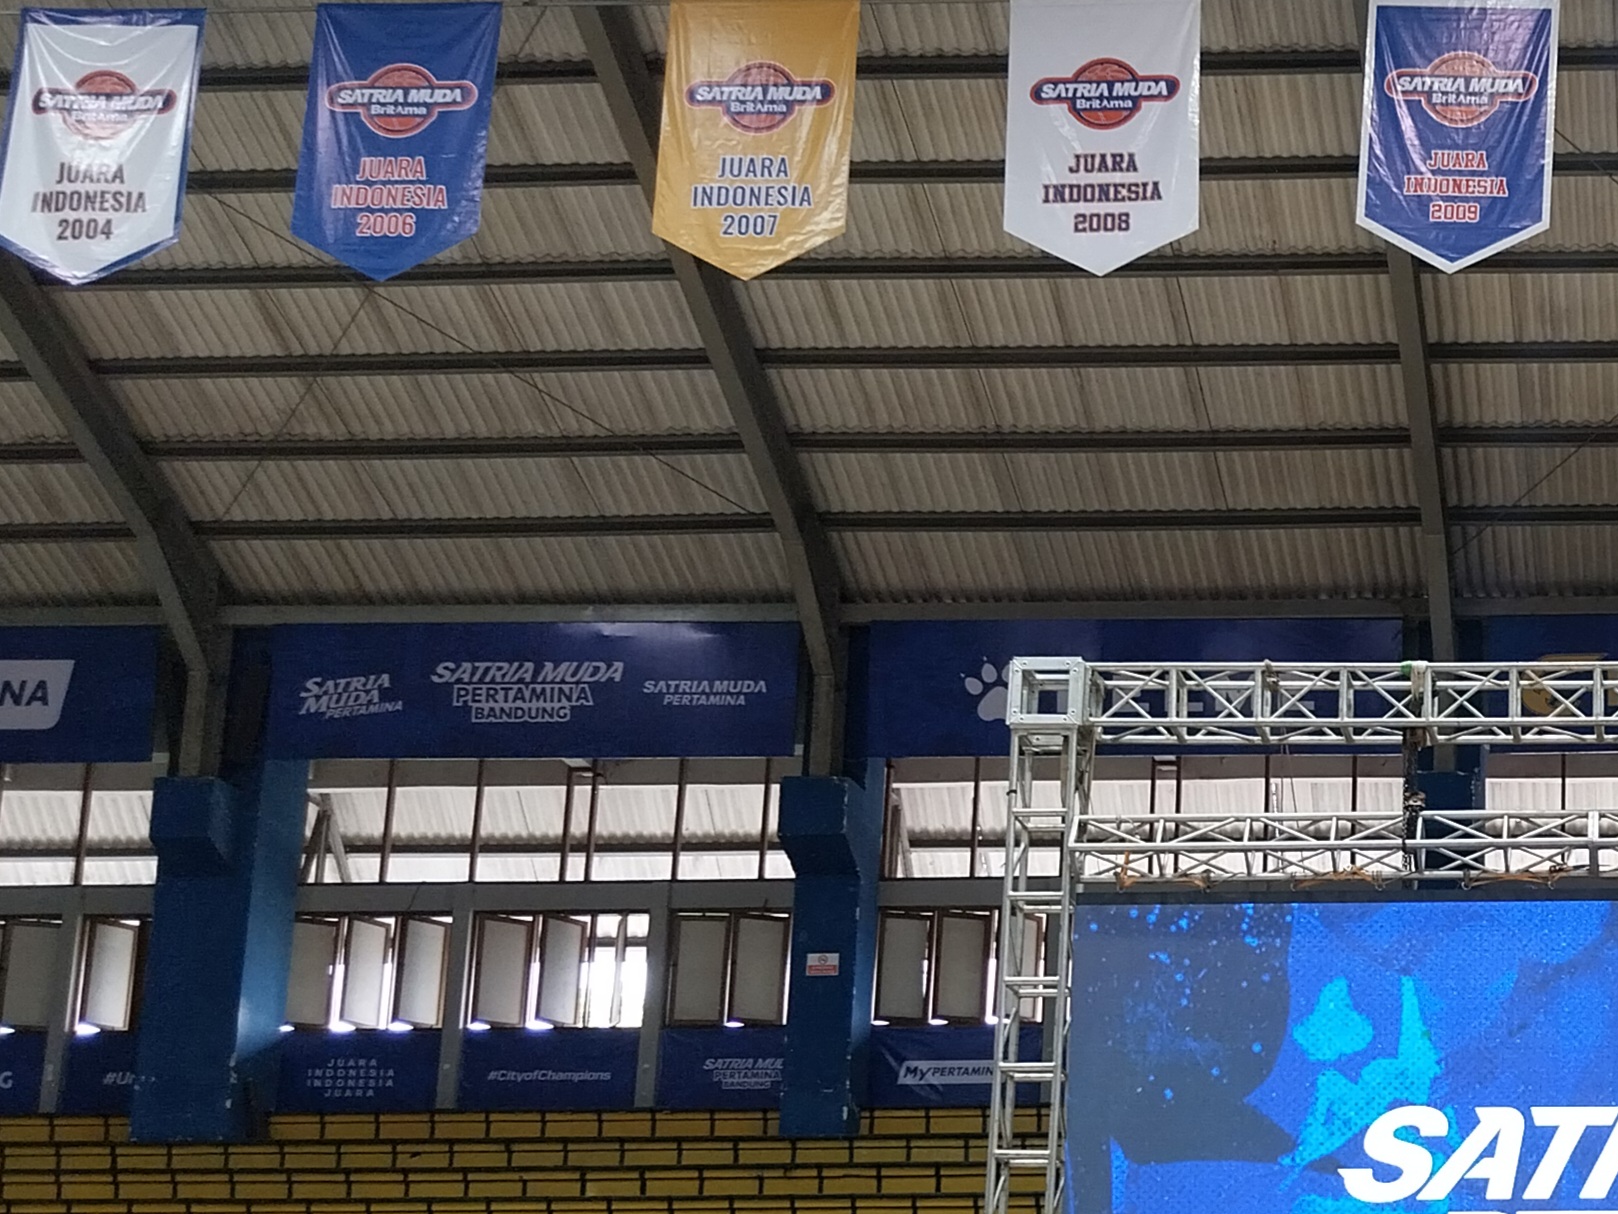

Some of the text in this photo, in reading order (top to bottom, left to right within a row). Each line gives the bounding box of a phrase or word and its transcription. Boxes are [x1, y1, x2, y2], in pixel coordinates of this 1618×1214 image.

[696, 85, 822, 101] SATRIA MUDA
[1041, 81, 1168, 98] SATRIA MUDA
[1399, 77, 1524, 93] SATRIA MUDA
[338, 88, 462, 103] SATRIA MUDA
[1075, 98, 1133, 109] BritAma
[1432, 92, 1488, 104] BritAma
[371, 104, 427, 115] BritAma
[730, 102, 787, 113] BritAma
[356, 156, 427, 180] JUARA
[718, 156, 789, 179] JUARA
[1068, 152, 1138, 174] JUARA
[1427, 150, 1488, 170] JUARA
[56, 161, 125, 185] JUARA
[1042, 181, 1163, 204] INDONESIA
[1404, 175, 1508, 197] INDONESIA
[31, 190, 147, 213] INDONESIA
[331, 185, 448, 209] INDONESIA
[692, 185, 813, 208] INDONESIA
[1430, 203, 1479, 222] 2009
[56, 218, 114, 241] 2004
[356, 213, 416, 237] 2006
[722, 214, 779, 237] 2007
[1073, 212, 1131, 233] 2008
[430, 661, 624, 683] SATRIA MUDA
[300, 674, 391, 697] SATRIA
[453, 685, 592, 705] PERTAMINA
[643, 680, 767, 695] SATRIA MUDA
[299, 690, 380, 715] MUDA
[662, 694, 746, 706] PERTAMINA
[325, 701, 403, 719] PERTAMINA
[472, 706, 570, 722] BANDUNG
[327, 1058, 378, 1068] JUARA
[703, 1058, 753, 1070] SATRIA
[307, 1068, 395, 1078] INDONESIA
[487, 1069, 612, 1083] #CityofChampions
[306, 1078, 394, 1088] INDONESIA
[323, 1088, 375, 1097] JUARA
